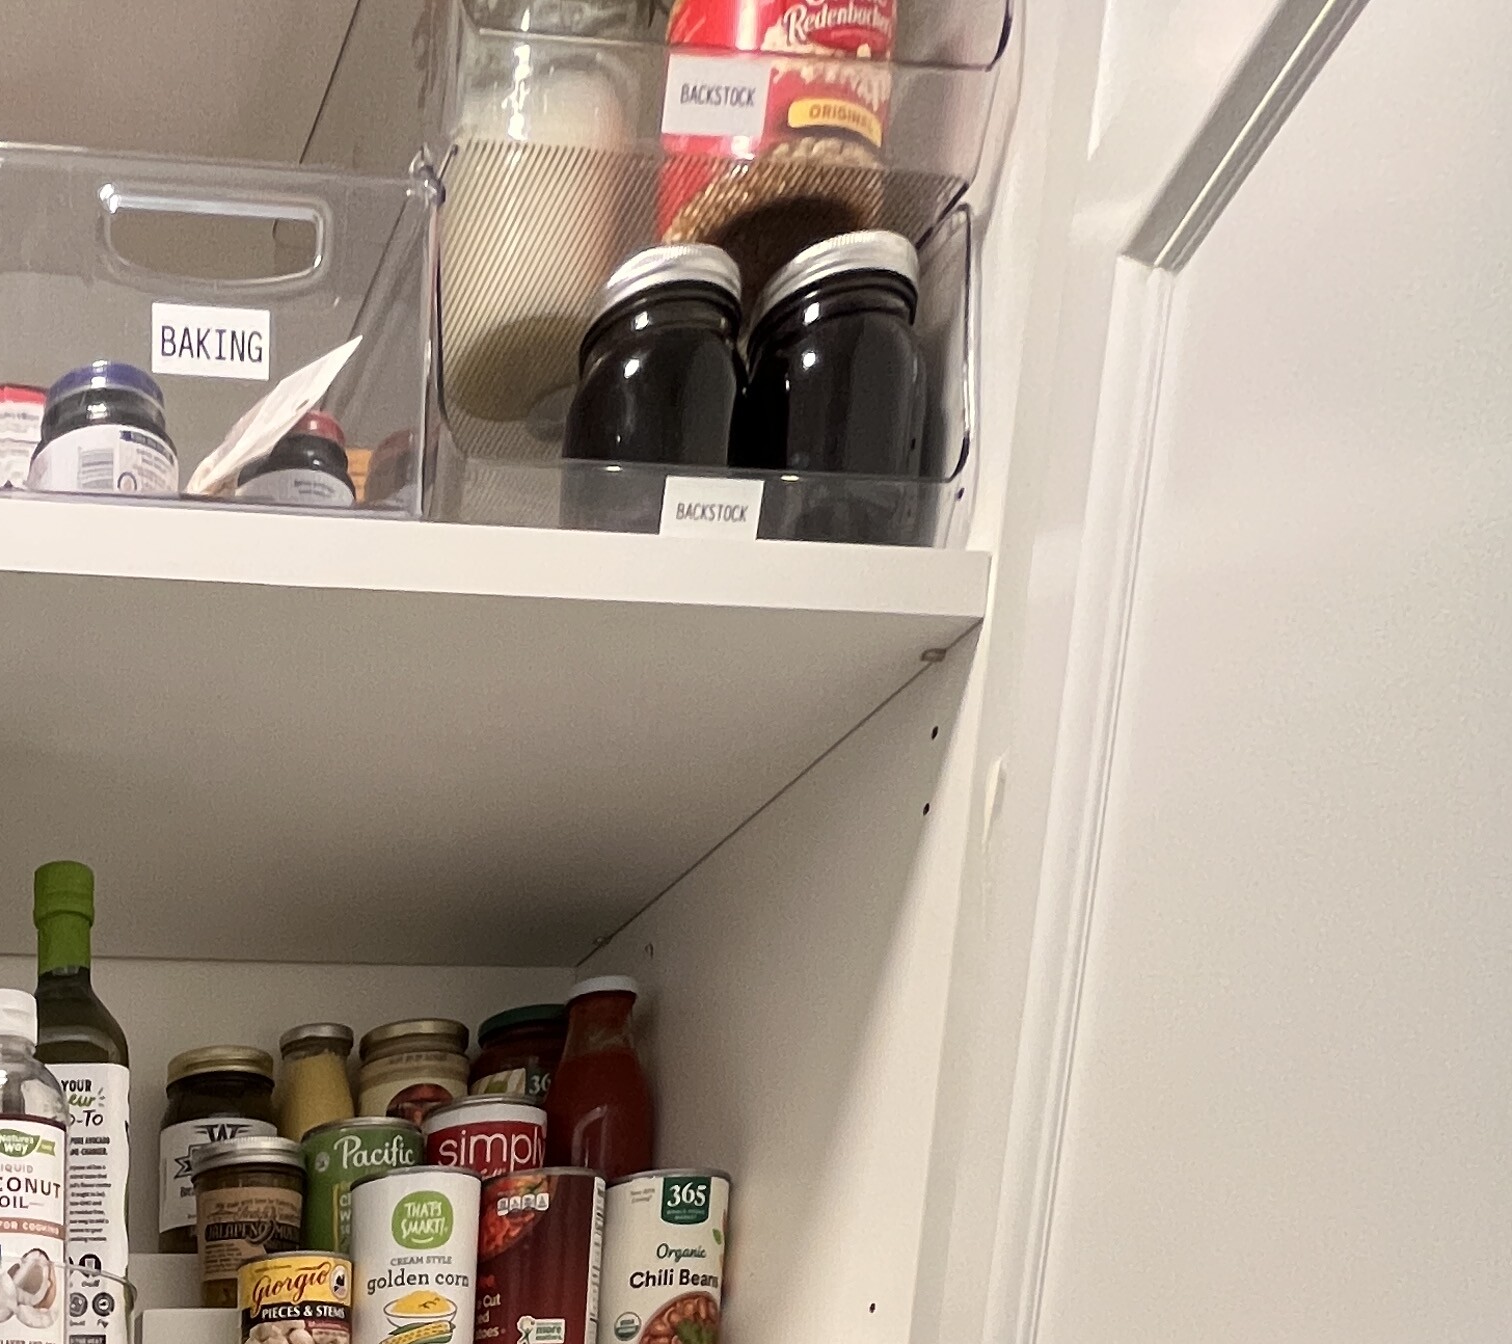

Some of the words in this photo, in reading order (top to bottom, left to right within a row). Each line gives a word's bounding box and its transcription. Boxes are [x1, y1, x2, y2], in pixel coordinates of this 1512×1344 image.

[680, 83, 755, 107] BACKSTOCK
[160, 326, 263, 363] BAKING
[676, 501, 748, 524] BACKSTOCK
[61, 1079, 92, 1092] YOUR
[3, 1142, 29, 1155] Way
[333, 1135, 416, 1169] Pacific
[666, 1181, 707, 1208] 365
[390, 1256, 424, 1267] CREAM
[425, 1255, 452, 1265] STYLE
[656, 1243, 706, 1263] Organic
[251, 1261, 332, 1319] Giorgio
[367, 1268, 430, 1295] golden
[435, 1272, 469, 1288] corn
[629, 1268, 674, 1289] Chili
[262, 1305, 300, 1319] PIECES
[303, 1304, 313, 1317] &
